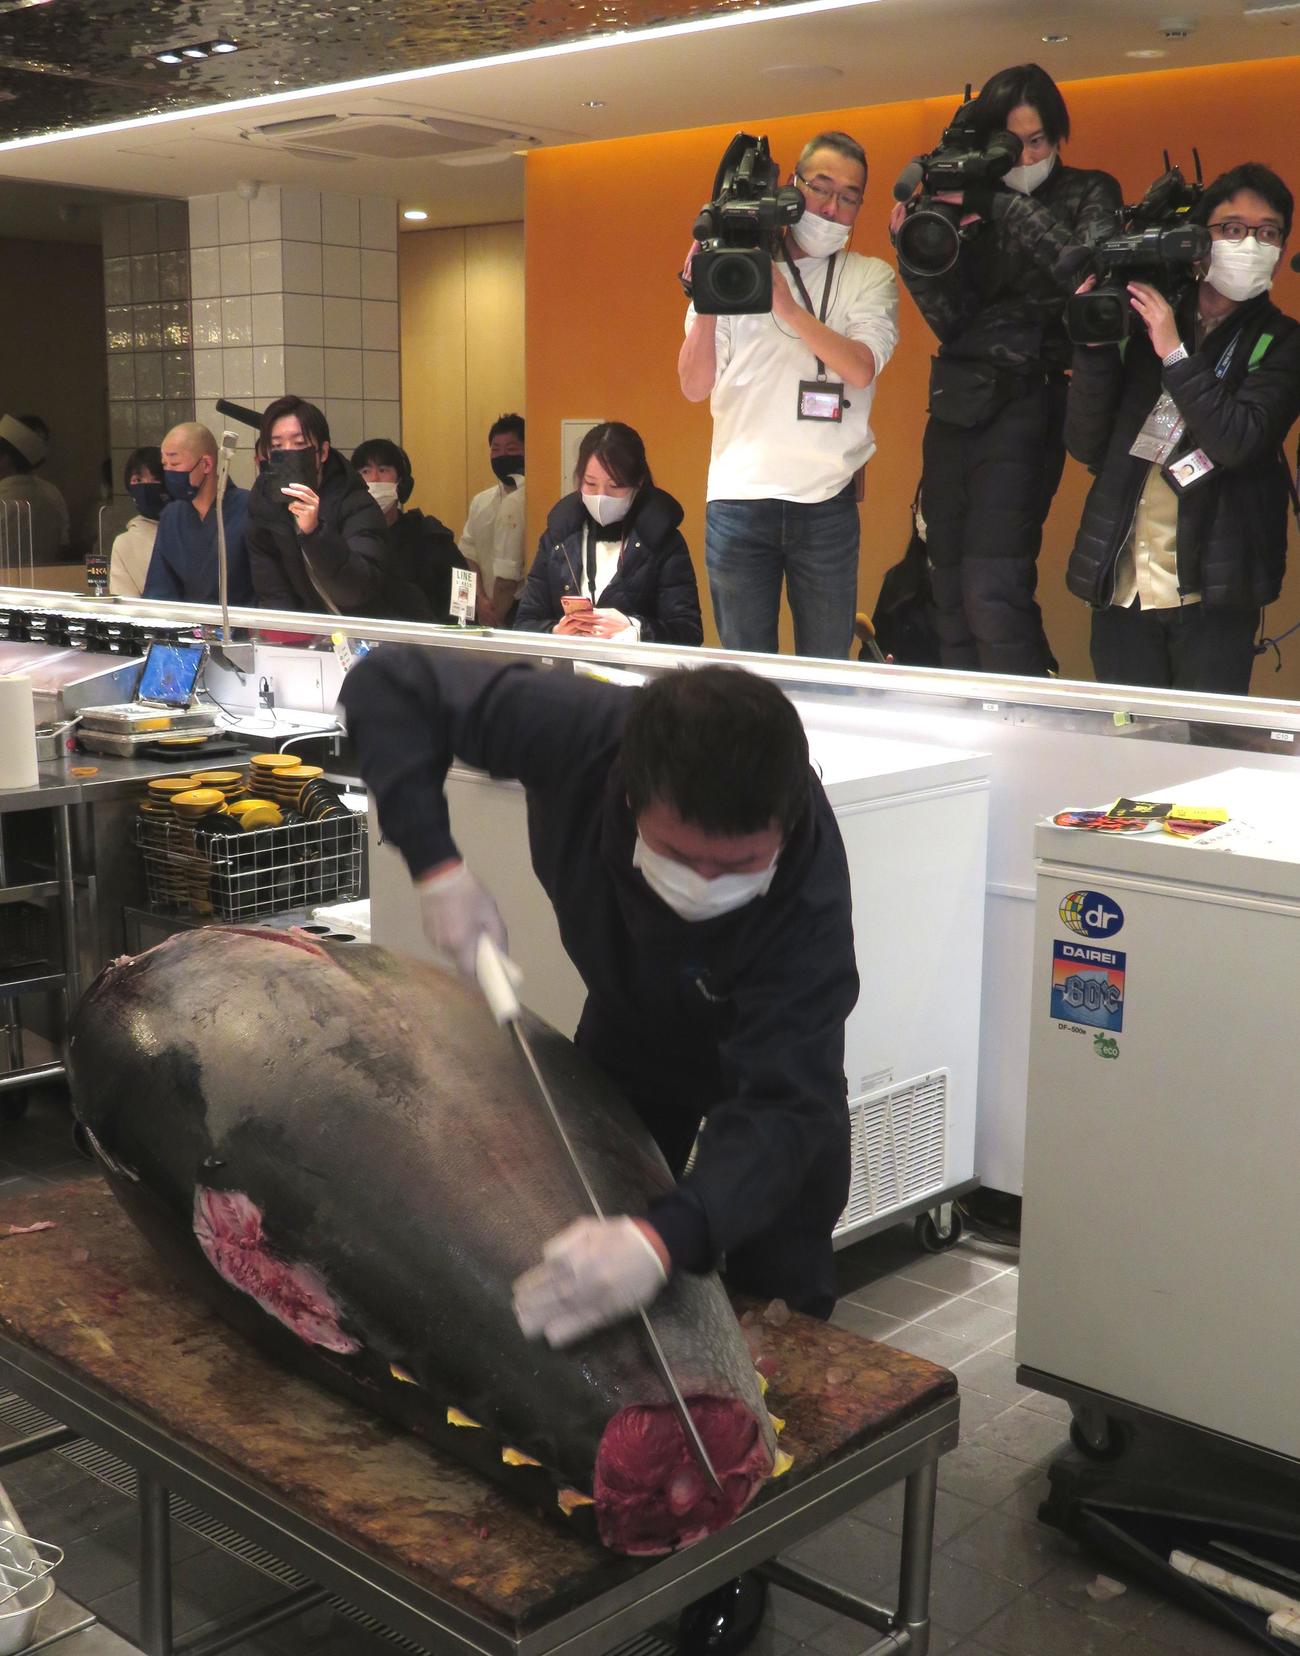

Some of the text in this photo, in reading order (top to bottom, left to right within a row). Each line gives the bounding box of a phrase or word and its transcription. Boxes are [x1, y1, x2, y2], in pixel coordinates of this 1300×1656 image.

[456, 570, 473, 582] LINE
[1085, 904, 1119, 929] dr
[1063, 945, 1116, 965] DAIREI
[1103, 1046, 1118, 1057] eco
